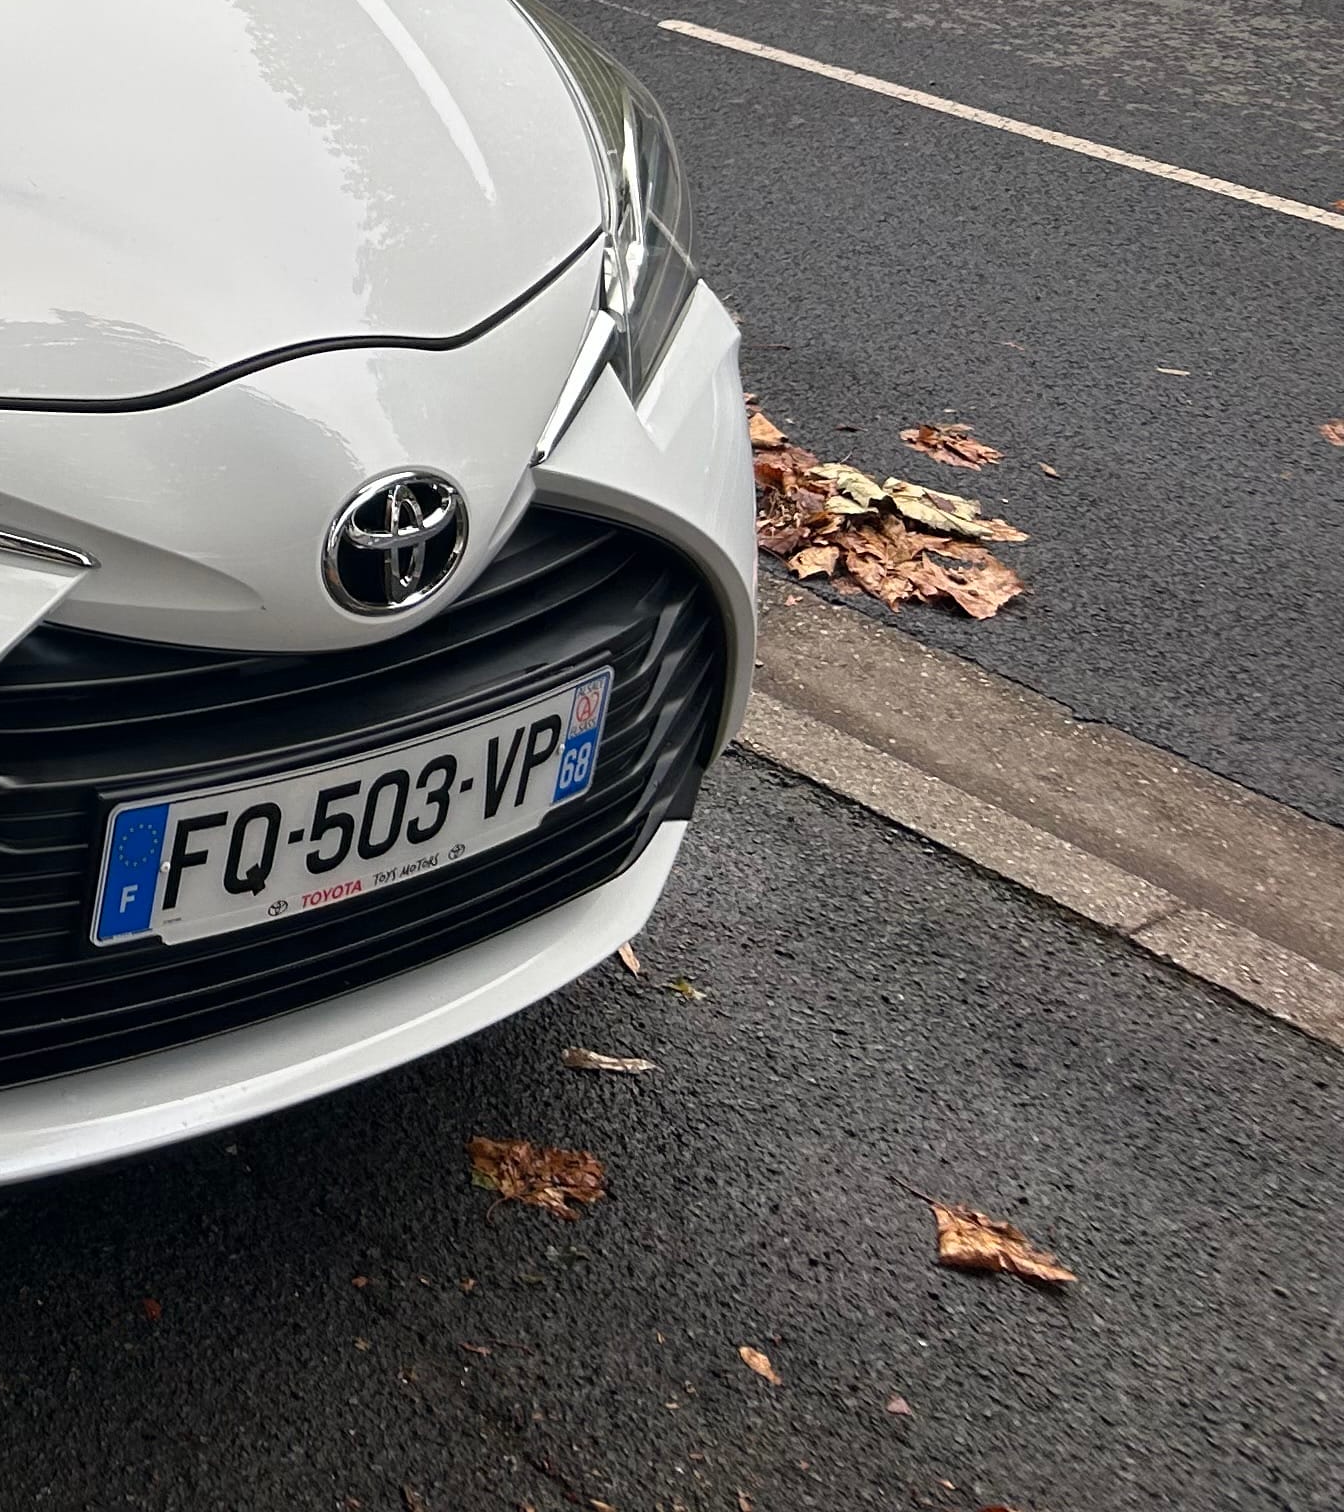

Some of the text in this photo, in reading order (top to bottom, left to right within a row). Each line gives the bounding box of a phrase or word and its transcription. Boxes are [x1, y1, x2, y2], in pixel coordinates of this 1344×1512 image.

[559, 741, 592, 790] 68
[162, 713, 562, 911] FQ-503-VP
[119, 884, 138, 913] F
[300, 879, 362, 909] TOYOTA
